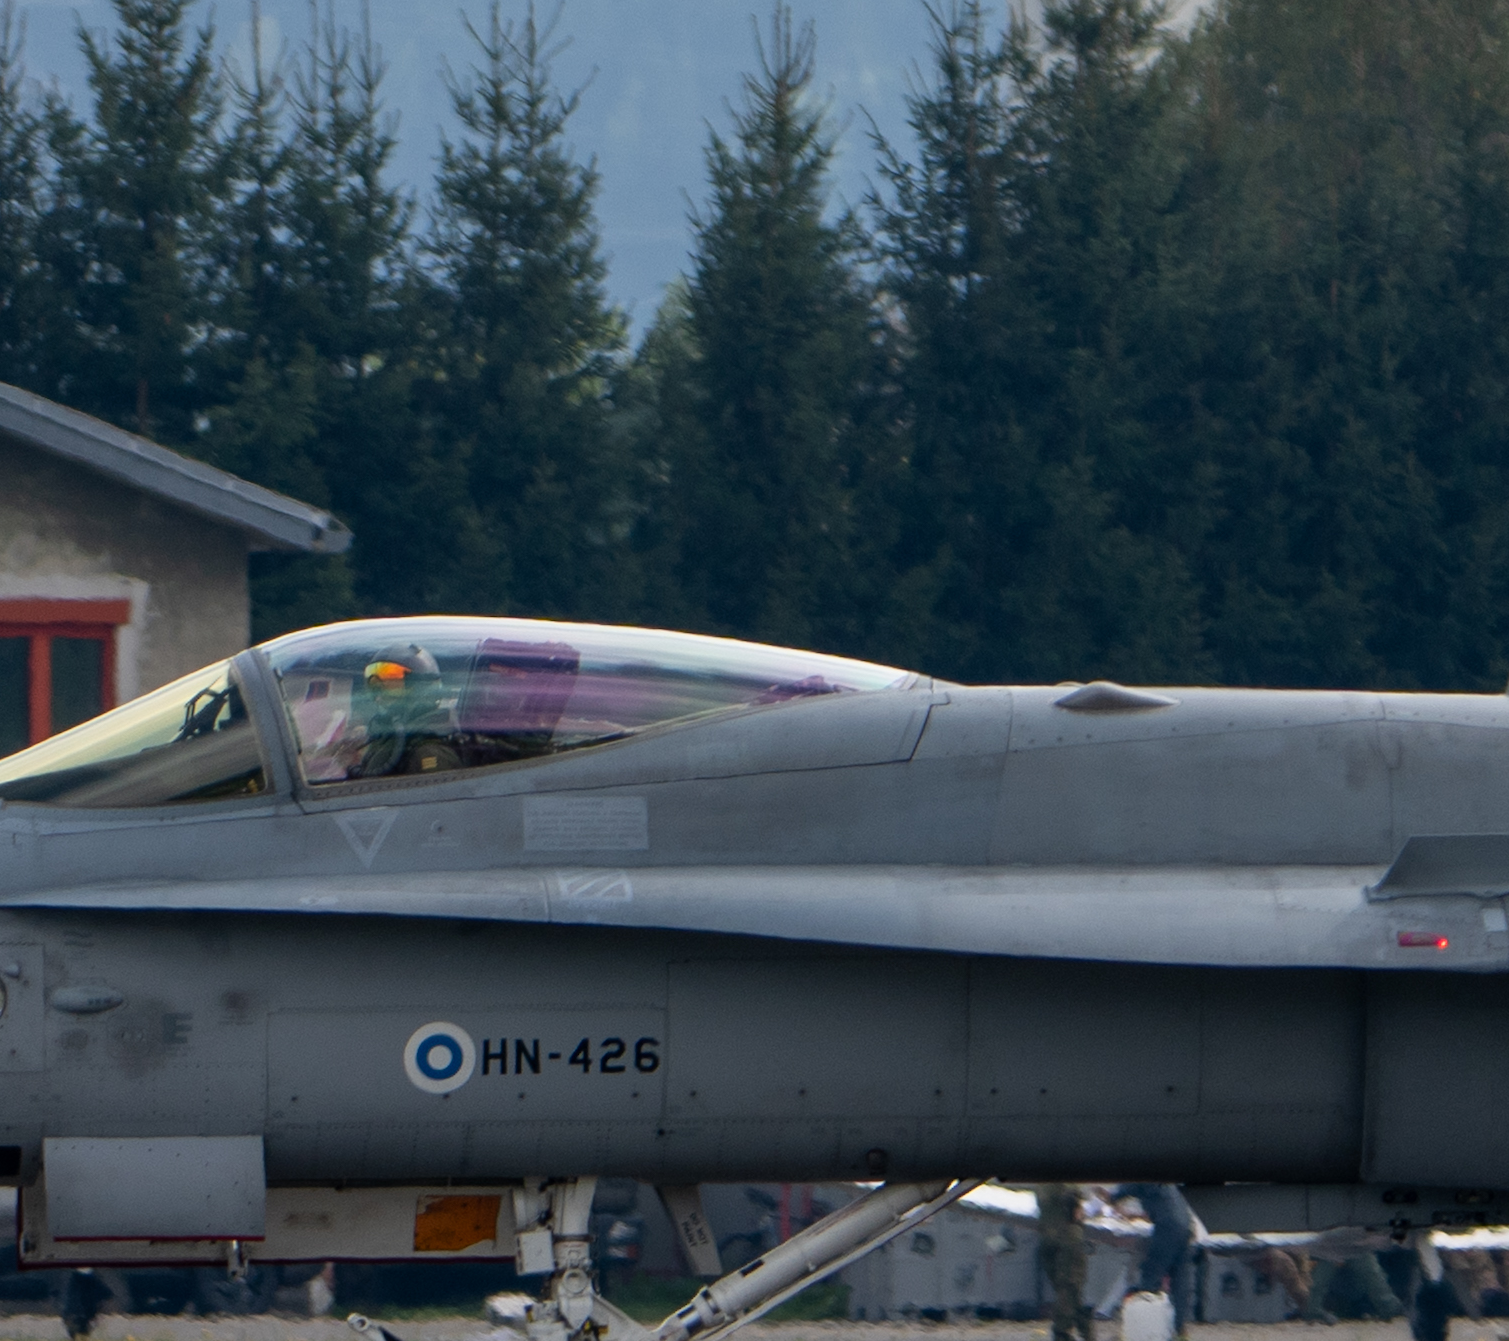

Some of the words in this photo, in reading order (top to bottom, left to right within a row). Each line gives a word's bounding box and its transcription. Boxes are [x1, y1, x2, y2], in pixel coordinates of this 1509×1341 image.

[481, 1037, 660, 1075] HN-426
[690, 1212, 700, 1225] DO
[697, 1228, 709, 1245] NOT
